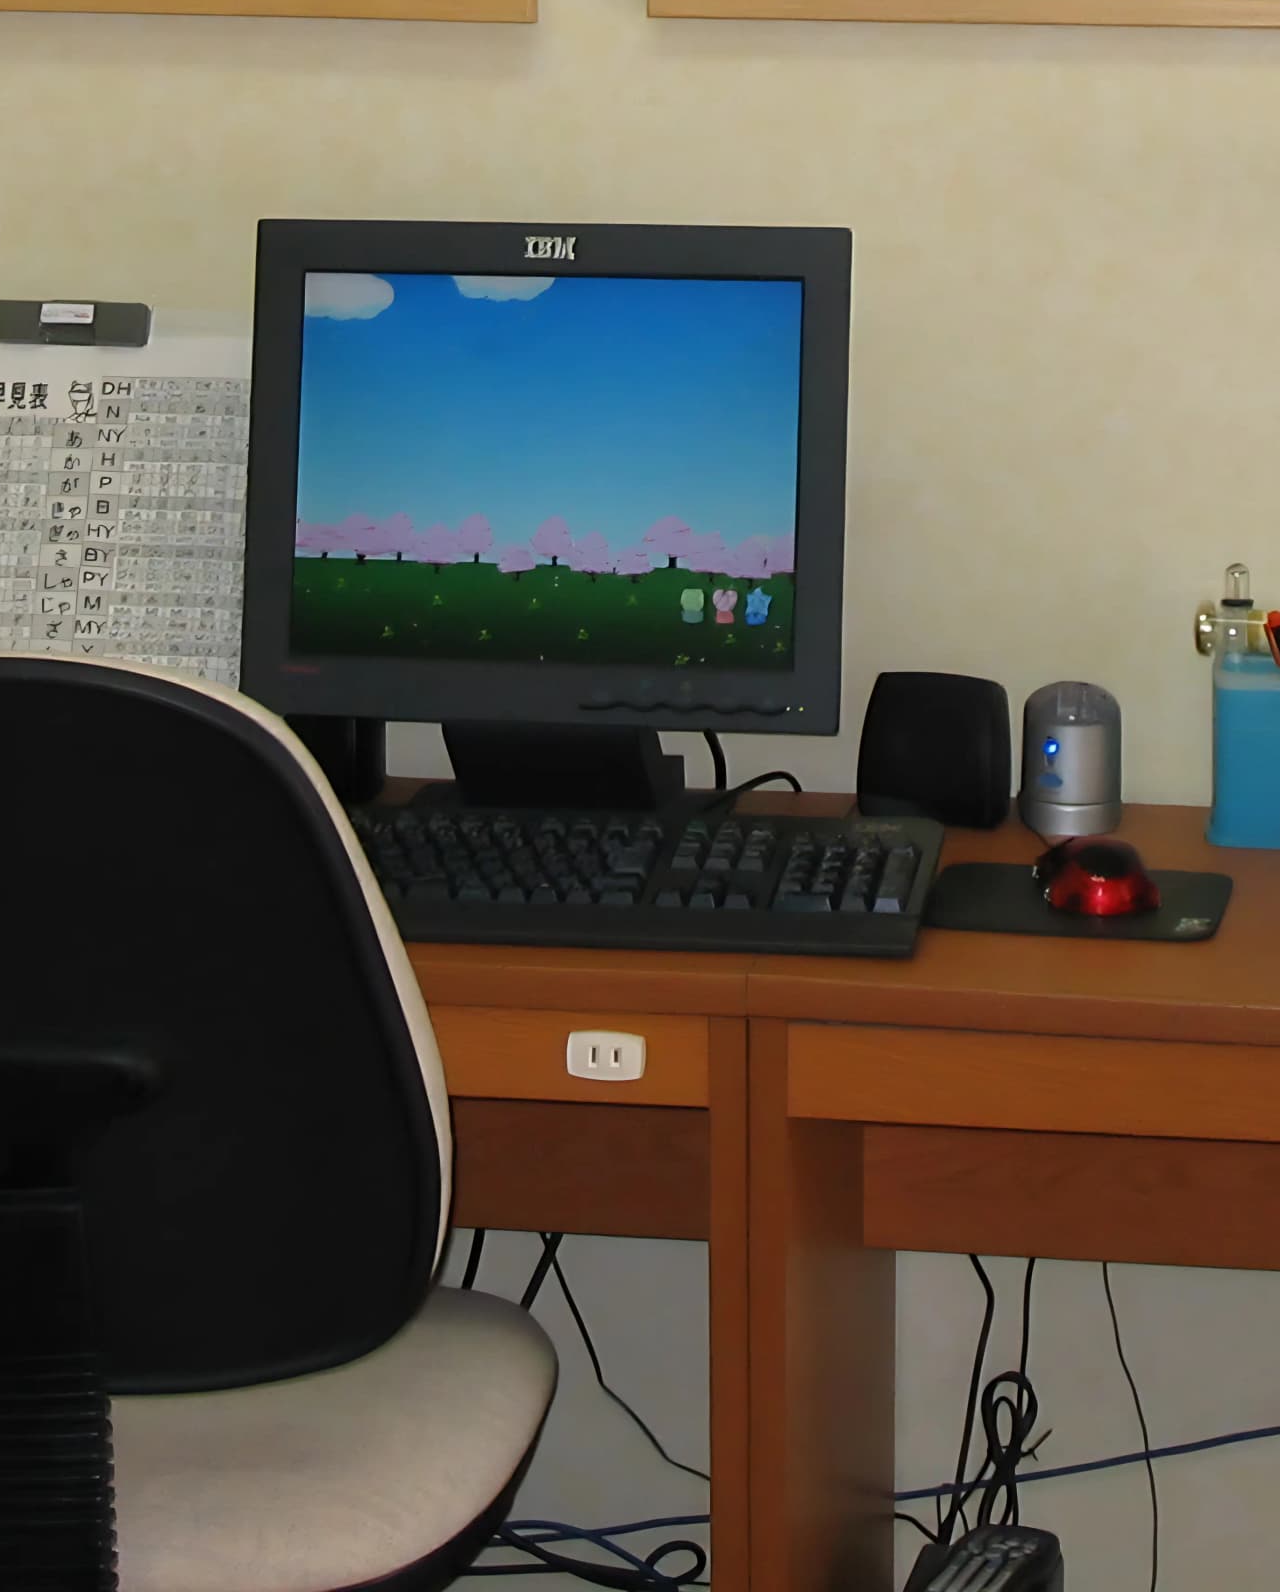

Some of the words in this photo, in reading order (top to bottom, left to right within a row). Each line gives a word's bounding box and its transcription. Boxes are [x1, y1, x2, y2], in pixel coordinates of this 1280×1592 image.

[524, 236, 577, 261] IBM
[101, 382, 132, 396] DH
[106, 405, 120, 419] N
[97, 426, 128, 443] NY
[101, 452, 116, 467] H
[99, 476, 112, 489] P
[87, 523, 115, 539] HY
[83, 571, 109, 586] PY
[84, 595, 101, 610] M
[74, 619, 106, 635] MY
